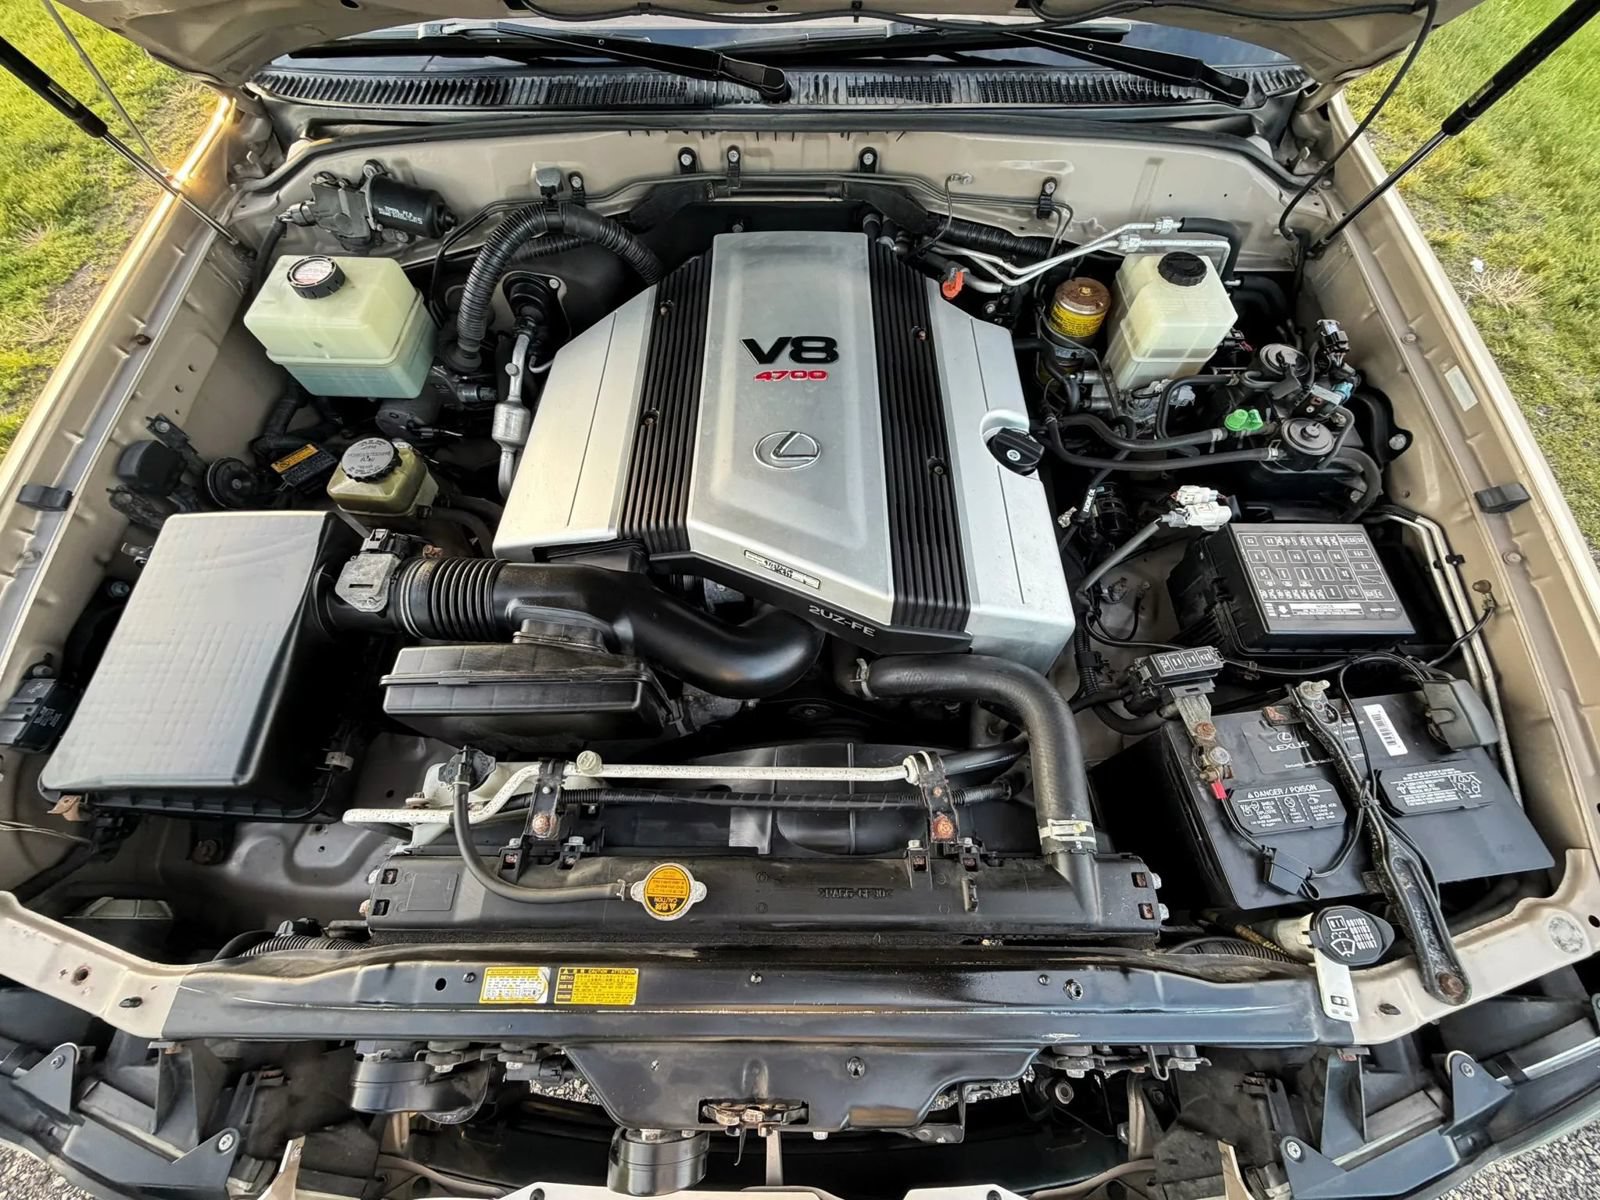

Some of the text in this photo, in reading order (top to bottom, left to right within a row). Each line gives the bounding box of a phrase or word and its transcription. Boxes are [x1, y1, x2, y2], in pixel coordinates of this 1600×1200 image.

[740, 336, 839, 364] V8
[753, 369, 828, 381] 4700
[809, 605, 876, 637] 2UZ-FE
[1268, 741, 1310, 752] LEXUS
[1254, 787, 1283, 798] DANGER
[1290, 784, 1317, 793] POISON
